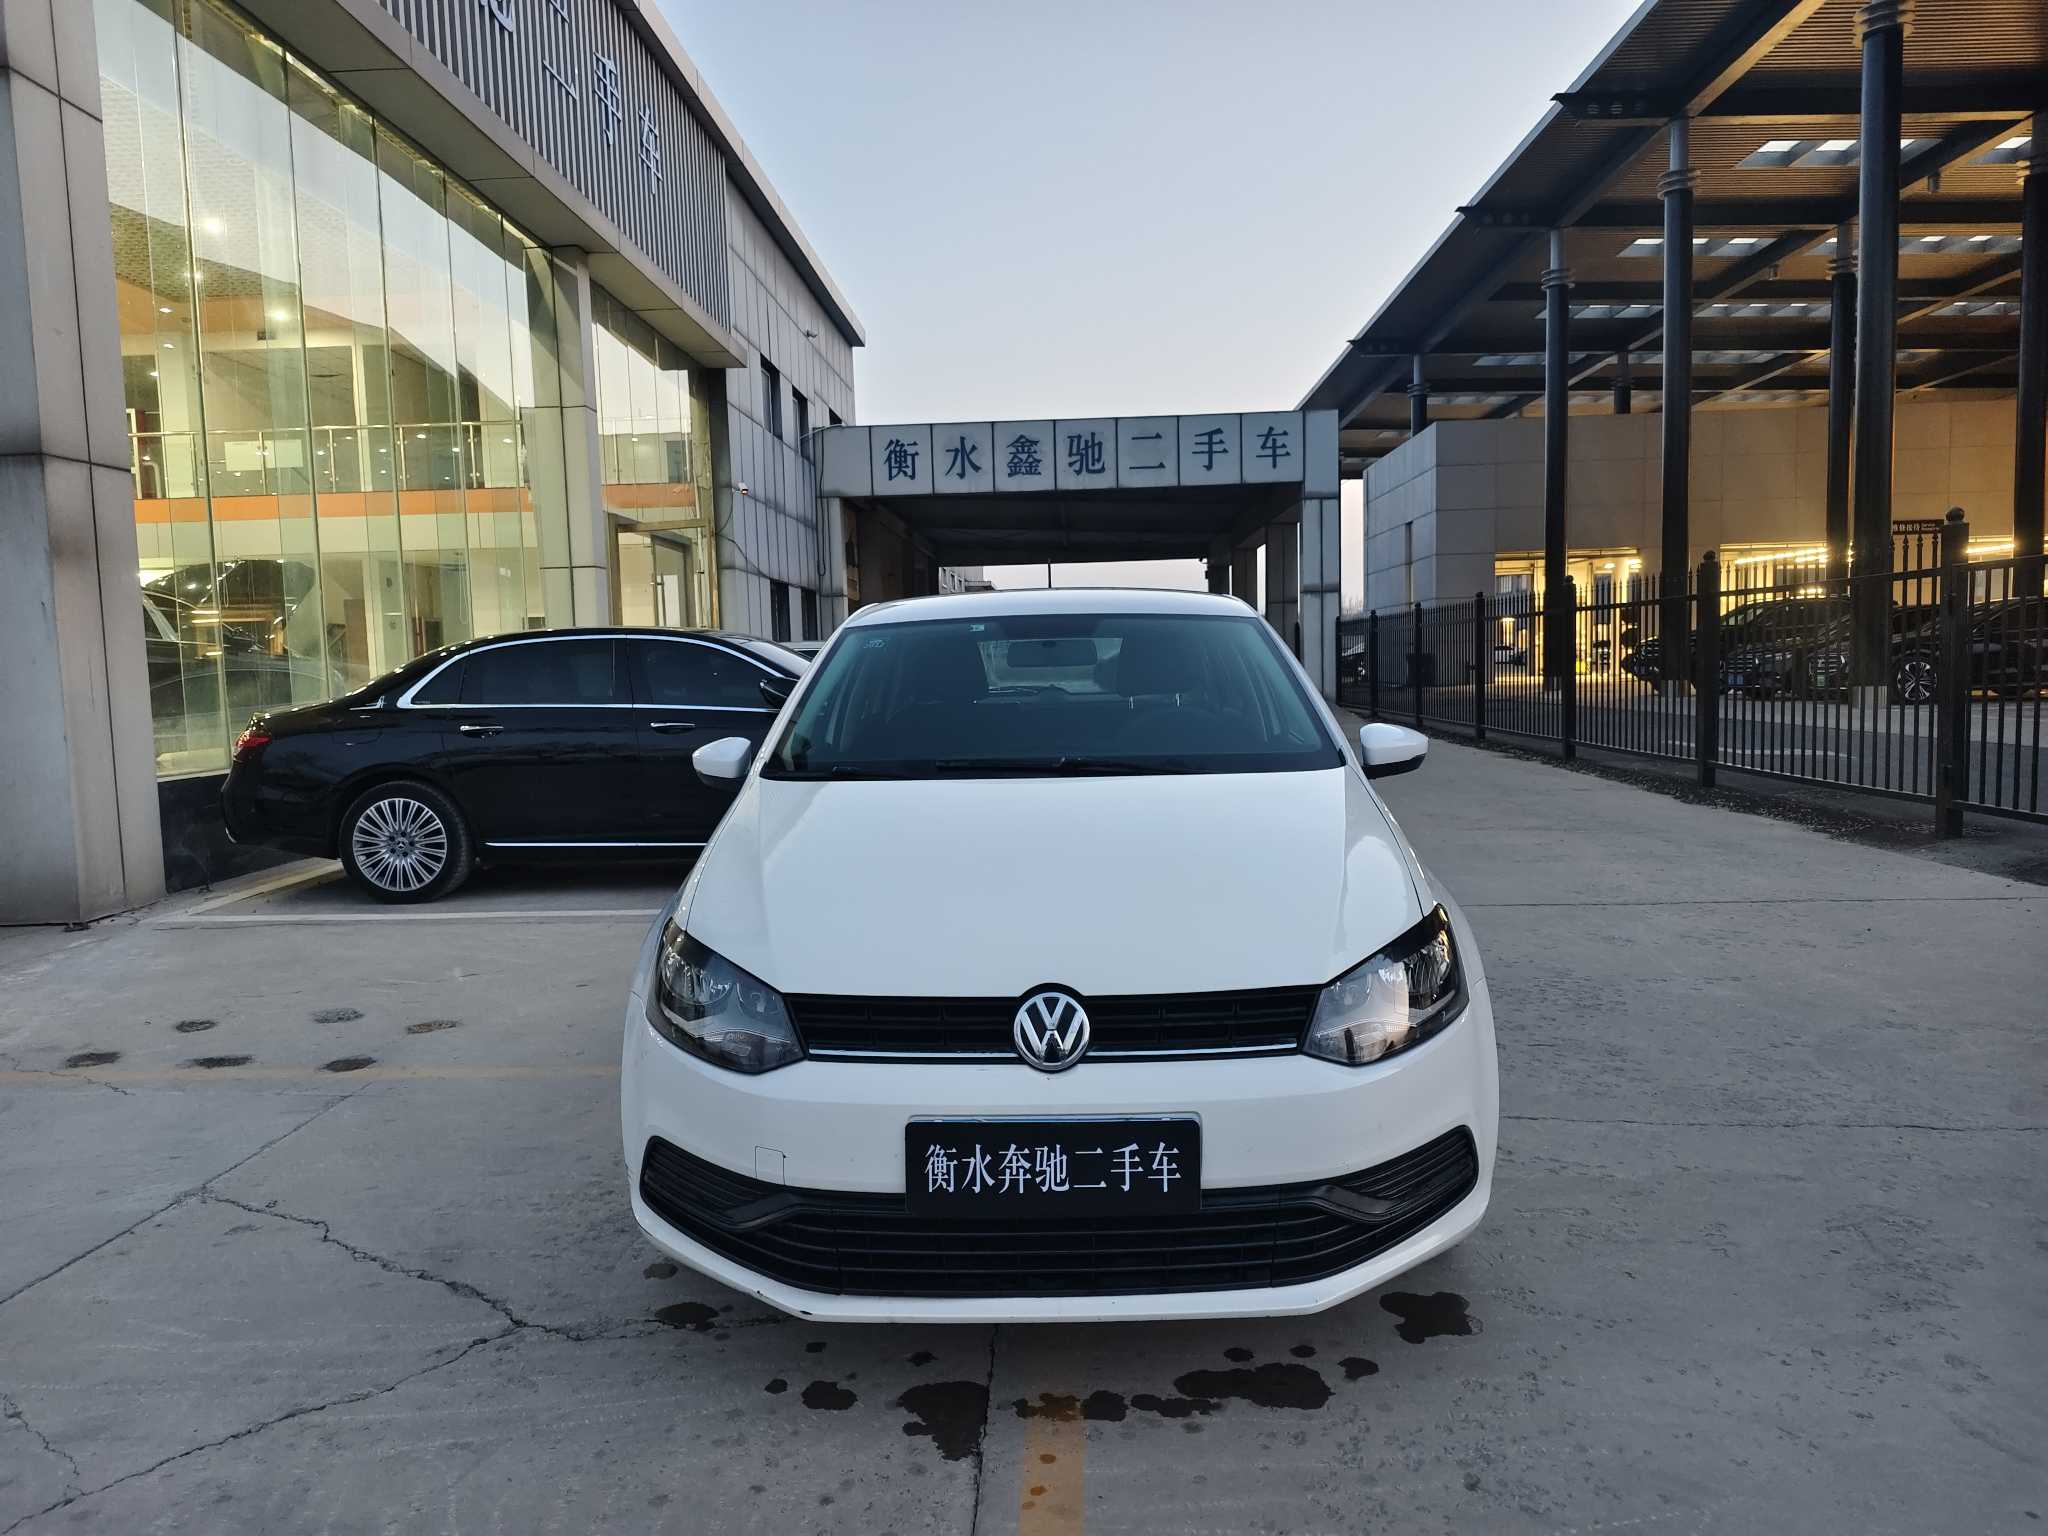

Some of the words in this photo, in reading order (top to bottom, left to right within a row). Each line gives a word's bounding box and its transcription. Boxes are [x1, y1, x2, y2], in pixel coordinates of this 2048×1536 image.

[883, 425, 1291, 481] 衡水鑫驰二手车
[925, 1142, 1181, 1194] 衡水奔驰二手车
